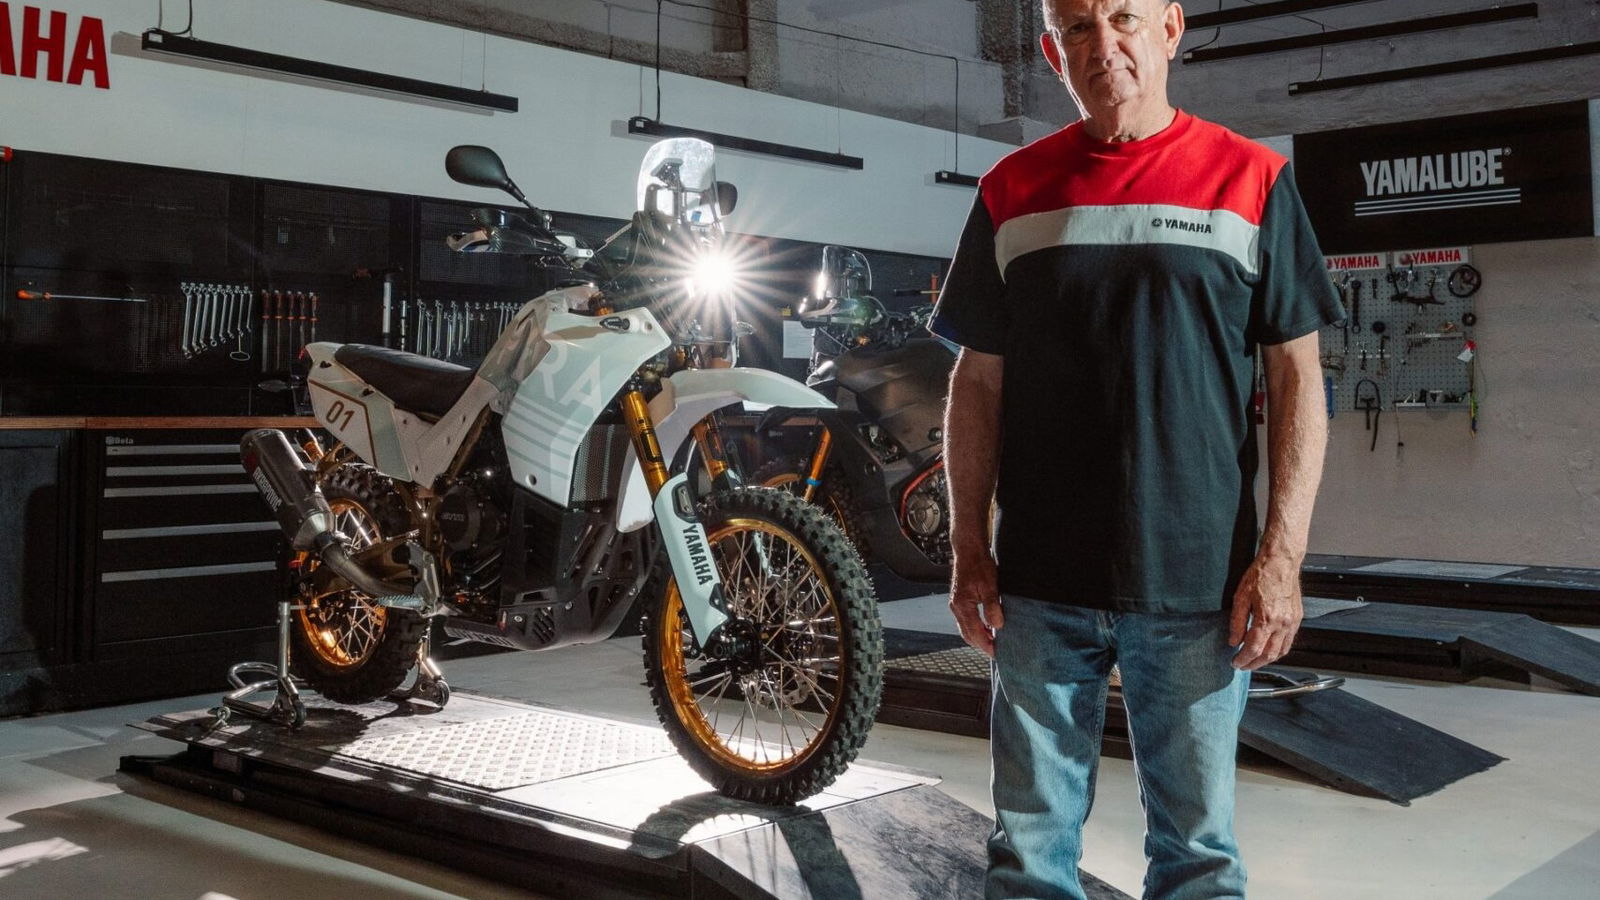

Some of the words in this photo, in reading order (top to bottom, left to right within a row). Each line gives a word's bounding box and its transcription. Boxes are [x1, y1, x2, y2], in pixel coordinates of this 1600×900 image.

[1164, 218, 1212, 234] YAMAHA
[1334, 255, 1380, 269] YAMAHA
[1410, 249, 1461, 264] YAMAHA
[326, 400, 355, 432] 01
[682, 524, 714, 586] YAMAHA
